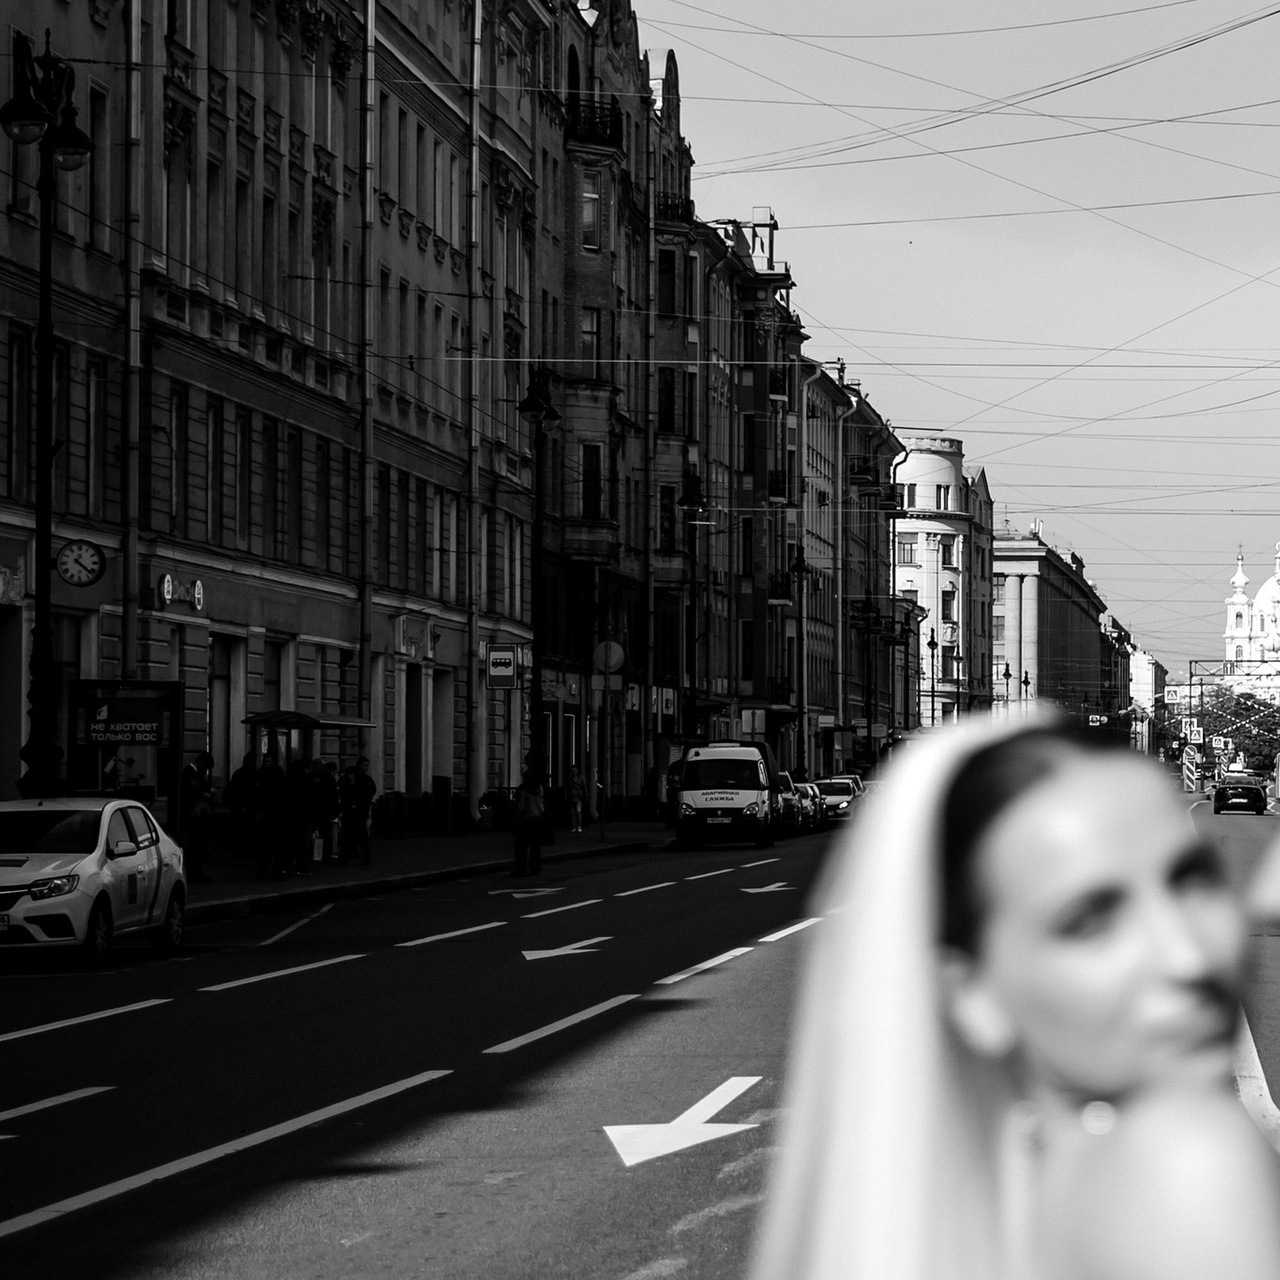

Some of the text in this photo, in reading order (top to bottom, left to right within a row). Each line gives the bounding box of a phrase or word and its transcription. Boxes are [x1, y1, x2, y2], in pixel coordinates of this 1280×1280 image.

[90, 723, 159, 731] не хватает
[90, 733, 157, 741] только вас
